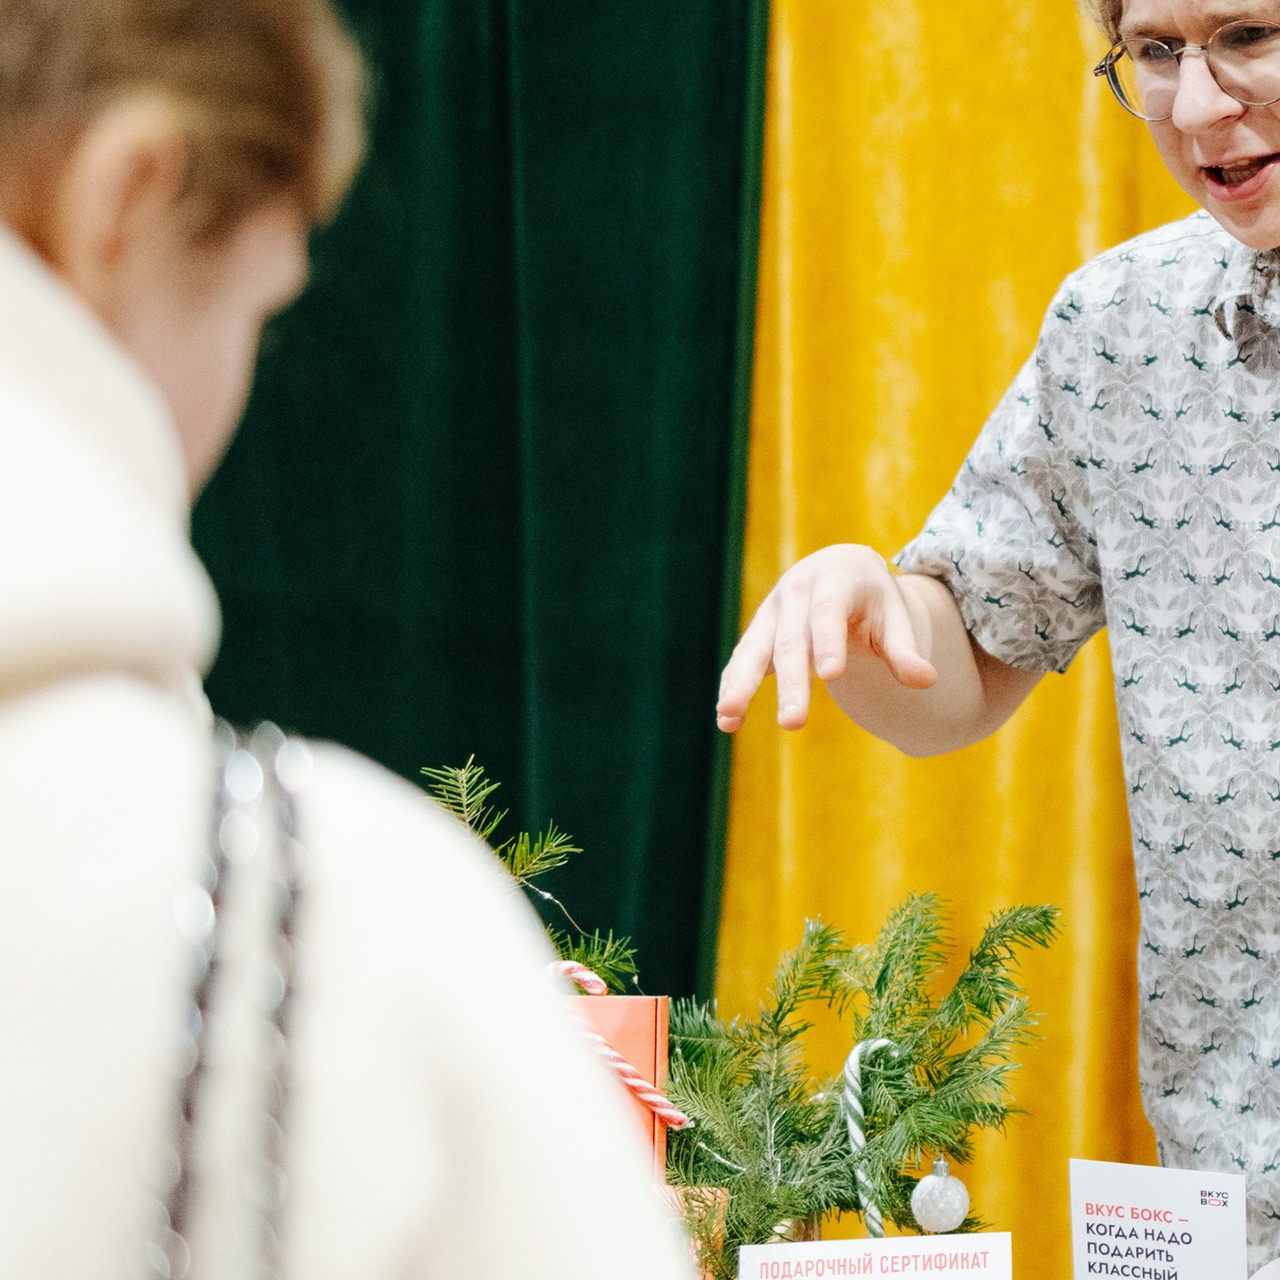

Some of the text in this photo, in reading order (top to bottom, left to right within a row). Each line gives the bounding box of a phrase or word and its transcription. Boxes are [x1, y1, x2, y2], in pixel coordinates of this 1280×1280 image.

[1200, 1190, 1229, 1199] ВКУС
[1200, 1198, 1229, 1207] BOX
[1085, 1203, 1125, 1218] ВКУС
[1130, 1207, 1173, 1223] БОКС
[1086, 1222, 1192, 1245] КОГДА НАДО
[1087, 1242, 1174, 1262] ПОДАРИТЬ
[759, 1251, 990, 1279] ПОДАРОЧНЫЙ СЕРТИФИКАТ
